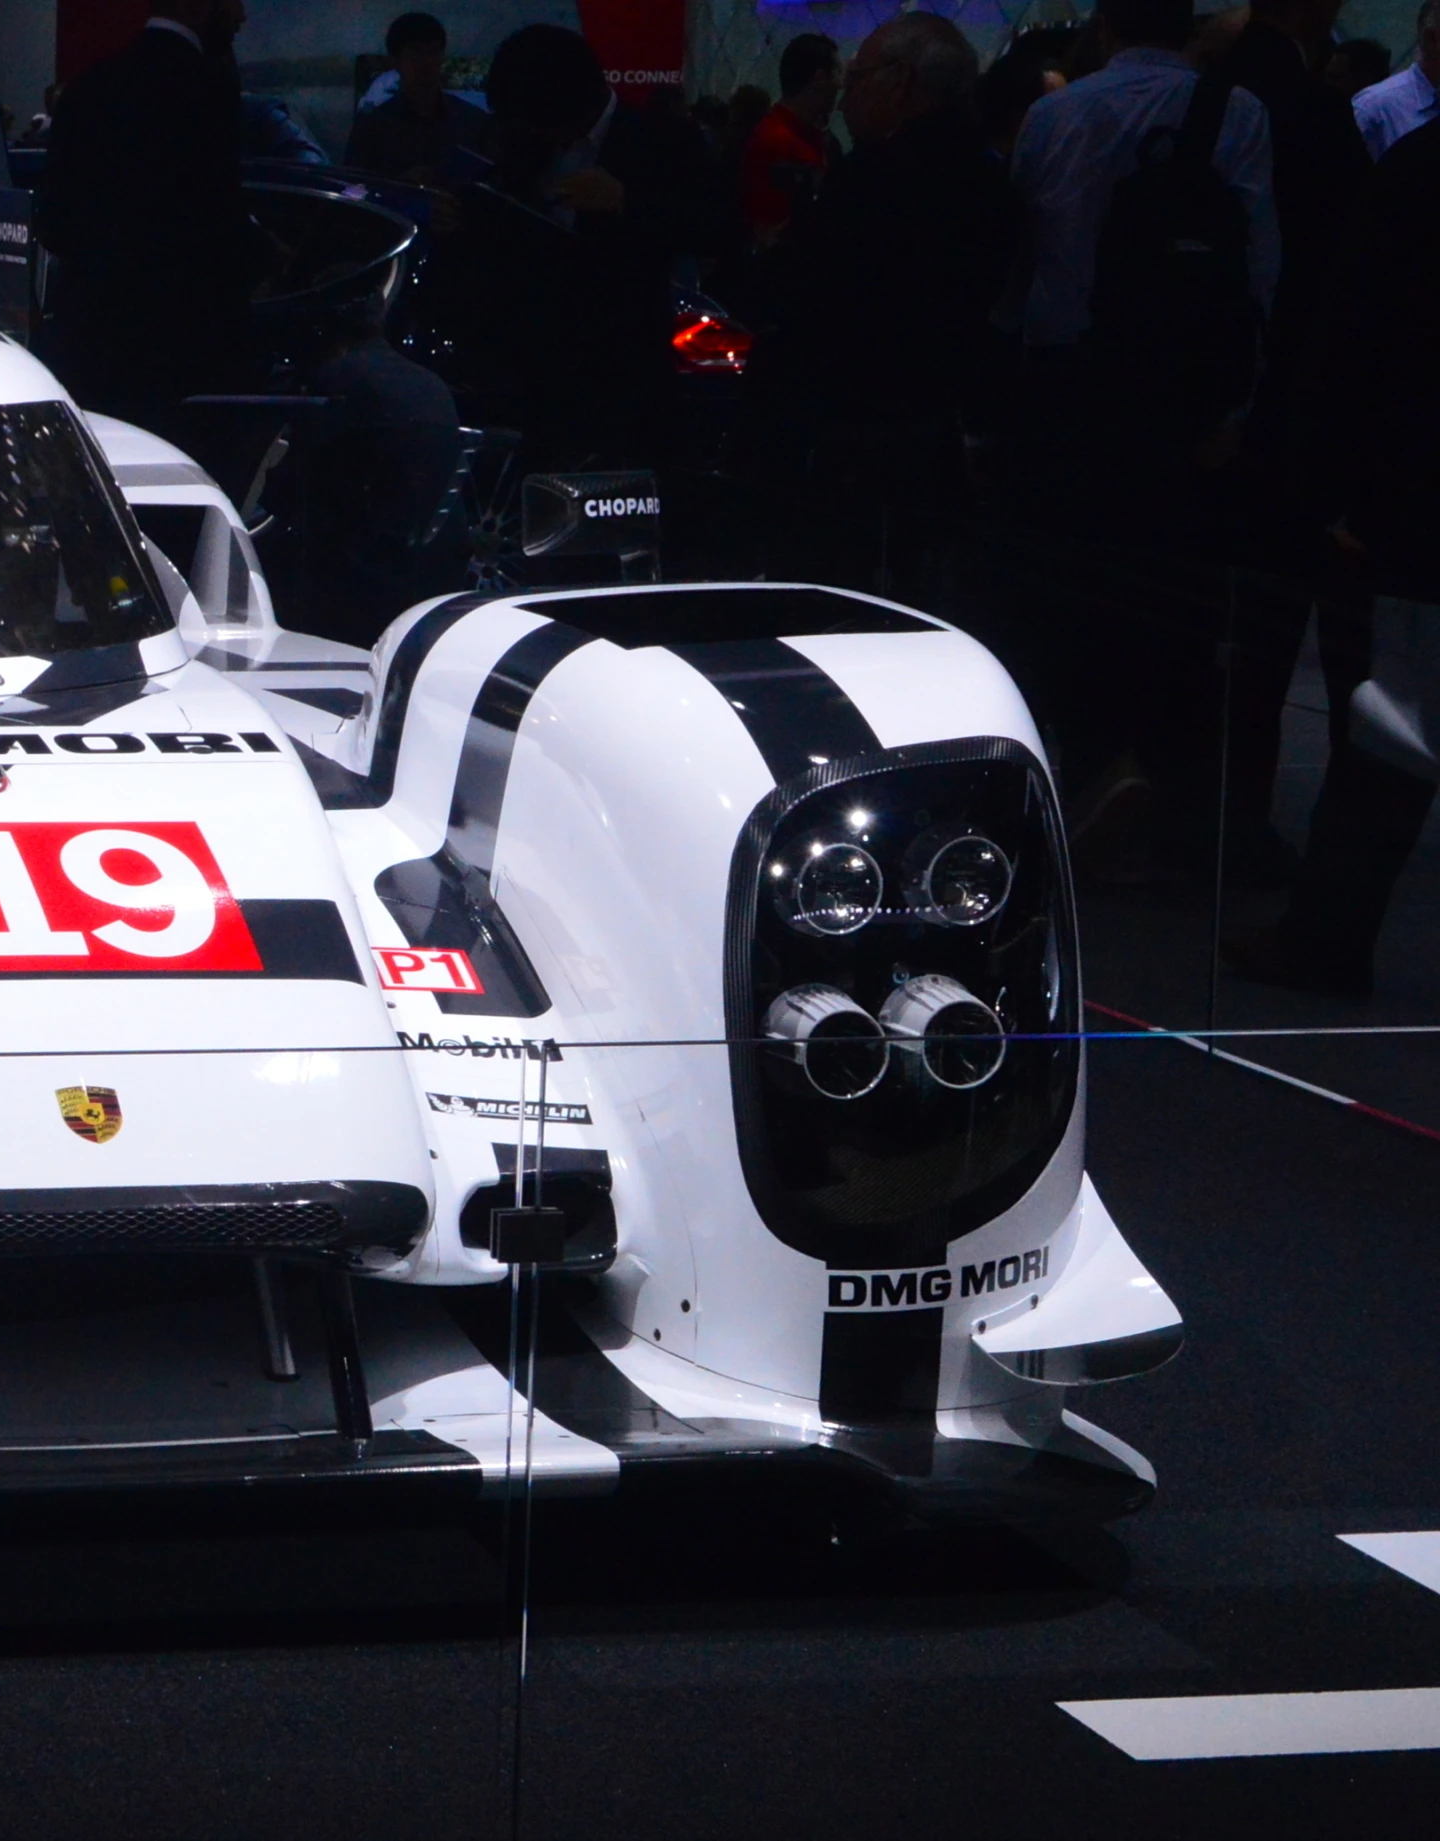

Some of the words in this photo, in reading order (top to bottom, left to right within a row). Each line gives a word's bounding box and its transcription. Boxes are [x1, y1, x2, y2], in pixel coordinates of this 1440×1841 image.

[624, 69, 683, 84] CONNE
[379, 951, 467, 988] P1
[828, 1269, 952, 1307] DMG
[960, 1246, 1050, 1298] MORI
